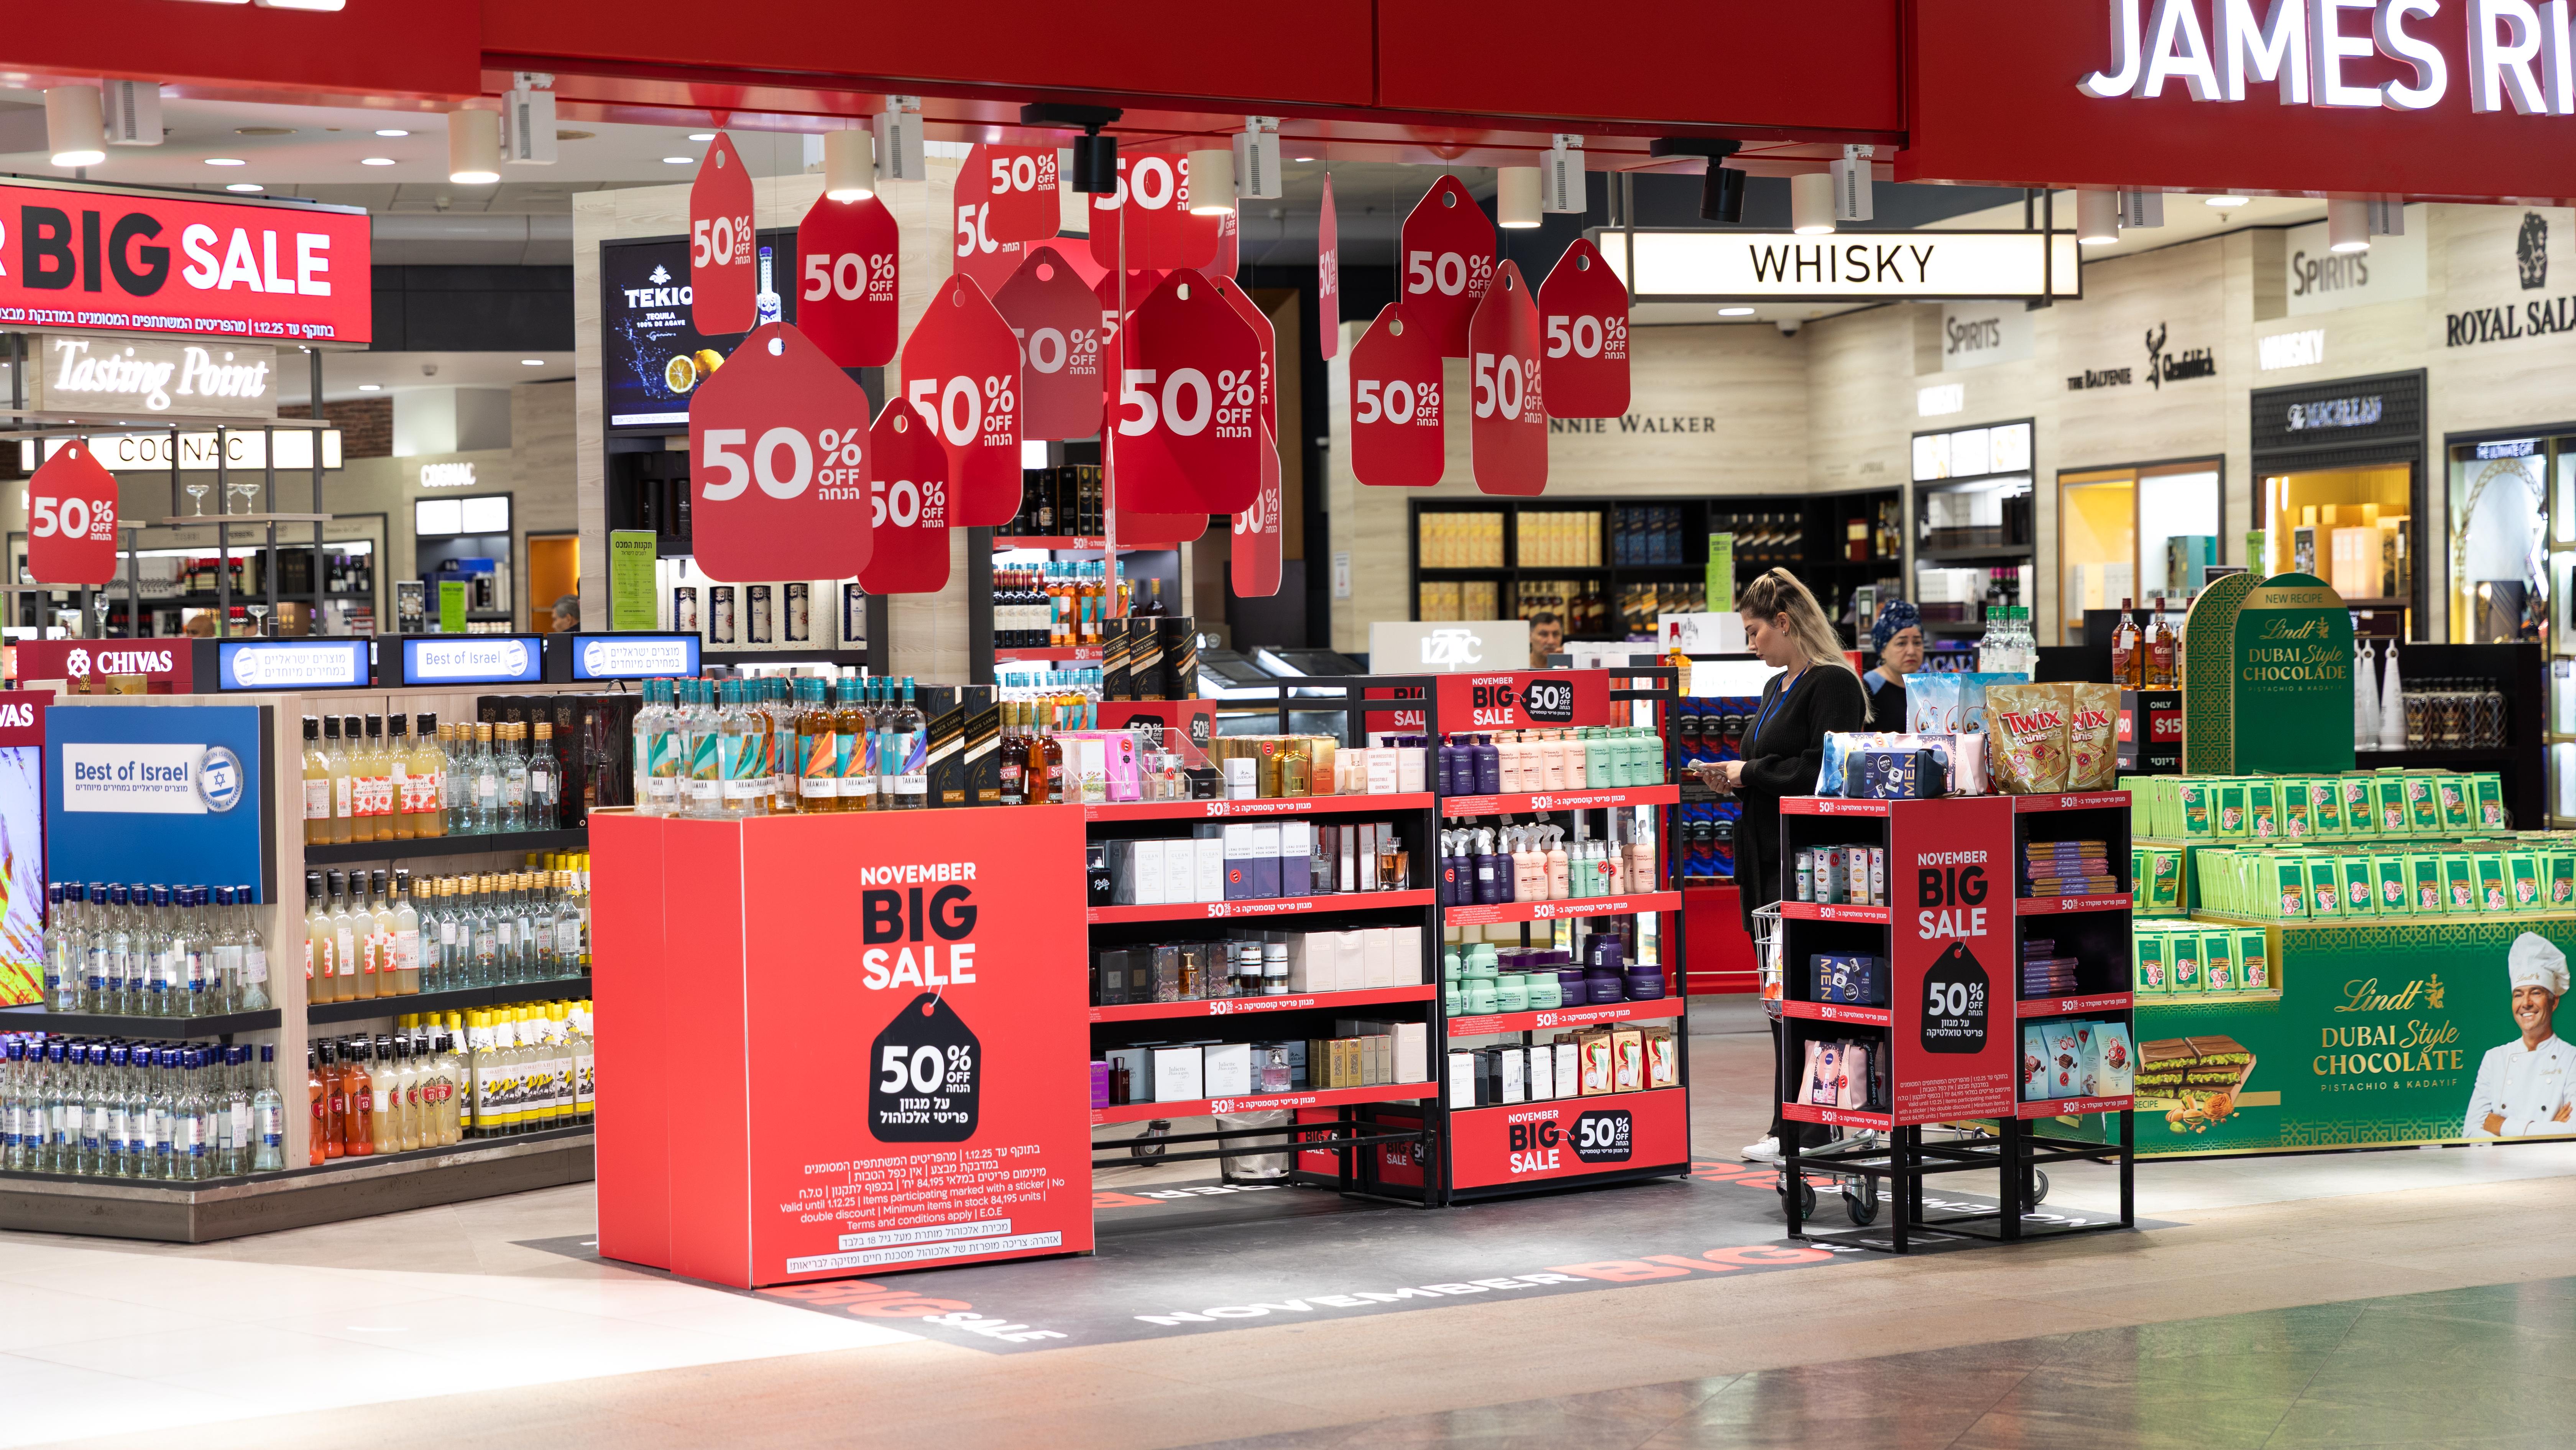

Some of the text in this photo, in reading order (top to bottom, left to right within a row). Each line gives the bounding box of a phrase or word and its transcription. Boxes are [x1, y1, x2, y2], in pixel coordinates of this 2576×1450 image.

[2076, 0, 2576, 117] JAMES RI
[992, 155, 1055, 194] 50%
[1038, 174, 1055, 184] OFF
[21, 205, 170, 296] BIG
[182, 223, 331, 296] SALE
[694, 216, 751, 268] 50%
[735, 243, 750, 255] OFF
[735, 255, 750, 265] הנחה
[1750, 245, 1934, 283] WHISKY
[804, 253, 895, 301] 50%
[869, 281, 893, 292] OFF
[869, 293, 893, 301] הנחה
[28, 309, 75, 324] במדבקת
[78, 313, 129, 326] המסומנים
[132, 314, 192, 330] המשתתפים
[646, 312, 675, 321] TEQUILA
[196, 319, 246, 332] מהפריטים
[254, 321, 283, 335] 1.12.25
[286, 323, 299, 335] עד
[302, 322, 335, 339] בתוקף
[2446, 306, 2522, 347] ROYAL
[1547, 316, 1626, 358] 50%
[1605, 341, 1625, 350] OFF
[54, 339, 269, 410] Tasting Point
[1118, 368, 1254, 436] 50%
[1357, 380, 1439, 424] 50%
[1217, 409, 1252, 423] OFF
[1417, 407, 1438, 417] OFF
[1417, 418, 1438, 426] הנחה
[1216, 426, 1252, 437] הנחה
[702, 427, 862, 501] 50%
[421, 463, 476, 487] COGNAC
[818, 469, 859, 485] OFF
[819, 488, 859, 500] הנחה
[33, 497, 113, 538] 50%
[91, 523, 112, 533] OFF
[615, 541, 652, 551] תקנות המכס
[2265, 593, 2322, 603] NEW RECIPE
[2259, 618, 2316, 640] Lindt
[97, 651, 172, 673] CHIVAS
[426, 651, 501, 665] Best of Israel
[2249, 644, 2344, 668] DUBAI Style
[2242, 665, 2347, 681] CHOCOLADE
[931, 716, 962, 734] BLACK LABEL
[2018, 731, 2047, 745] minis
[76, 761, 188, 781] Best of Israel
[1904, 755, 1914, 796] MEN
[1206, 802, 1230, 816] 50%
[1241, 804, 1274, 813] קוסמטיקה
[1296, 802, 1311, 810] מגוון
[1918, 850, 1987, 866] NOVEMBER
[861, 862, 976, 885] NOVEMBER
[1919, 866, 1988, 907] BIG
[863, 884, 977, 945] BIG
[1919, 908, 1987, 939] SALE
[863, 943, 976, 990] SALE
[1929, 982, 1984, 1016] 50%
[2334, 978, 2424, 1013] Lindt
[1941, 1019, 1958, 1027] מגוון
[1927, 1028, 1983, 1037] פריטי טואלטיקה
[2321, 1020, 2459, 1051] DUBAI Style
[880, 1045, 971, 1093] 50%
[1218, 1062, 1235, 1070] Juliette
[2313, 1049, 2464, 1076] CHOCOLATE
[946, 1072, 970, 1082] OFF
[2321, 1078, 2458, 1092] PISTACHIO & KADAYIF
[946, 1084, 970, 1092] הנחה
[900, 1097, 950, 1112] על מגוון
[880, 1111, 968, 1123] פריטי אלכוהול
[1508, 1110, 1558, 1123] NOVEMBER
[1509, 1120, 1559, 1151] BIG
[1580, 1117, 1628, 1147] 50%
[1510, 1149, 1560, 1173] SALE
[780, 1202, 802, 1212] Valid
[805, 1200, 825, 1210] until
[828, 1197, 855, 1208] 1.12.25
[863, 1195, 888, 1205] Items
[890, 1188, 948, 1203] participating
[950, 1185, 983, 1196] marked
[986, 1182, 1005, 1193] with
[1015, 1179, 1044, 1190] sticker
[1053, 1178, 1065, 1187] No
[801, 1192, 1040, 1223] double discount Minimum items in stock 84,195 units
[847, 1207, 1002, 1230] Terms and conditions apply E.O.E
[1134, 1245, 1835, 1326] NOVEMBER BIG
[755, 1280, 972, 1317] BIG
[923, 1312, 1068, 1342] SALE
